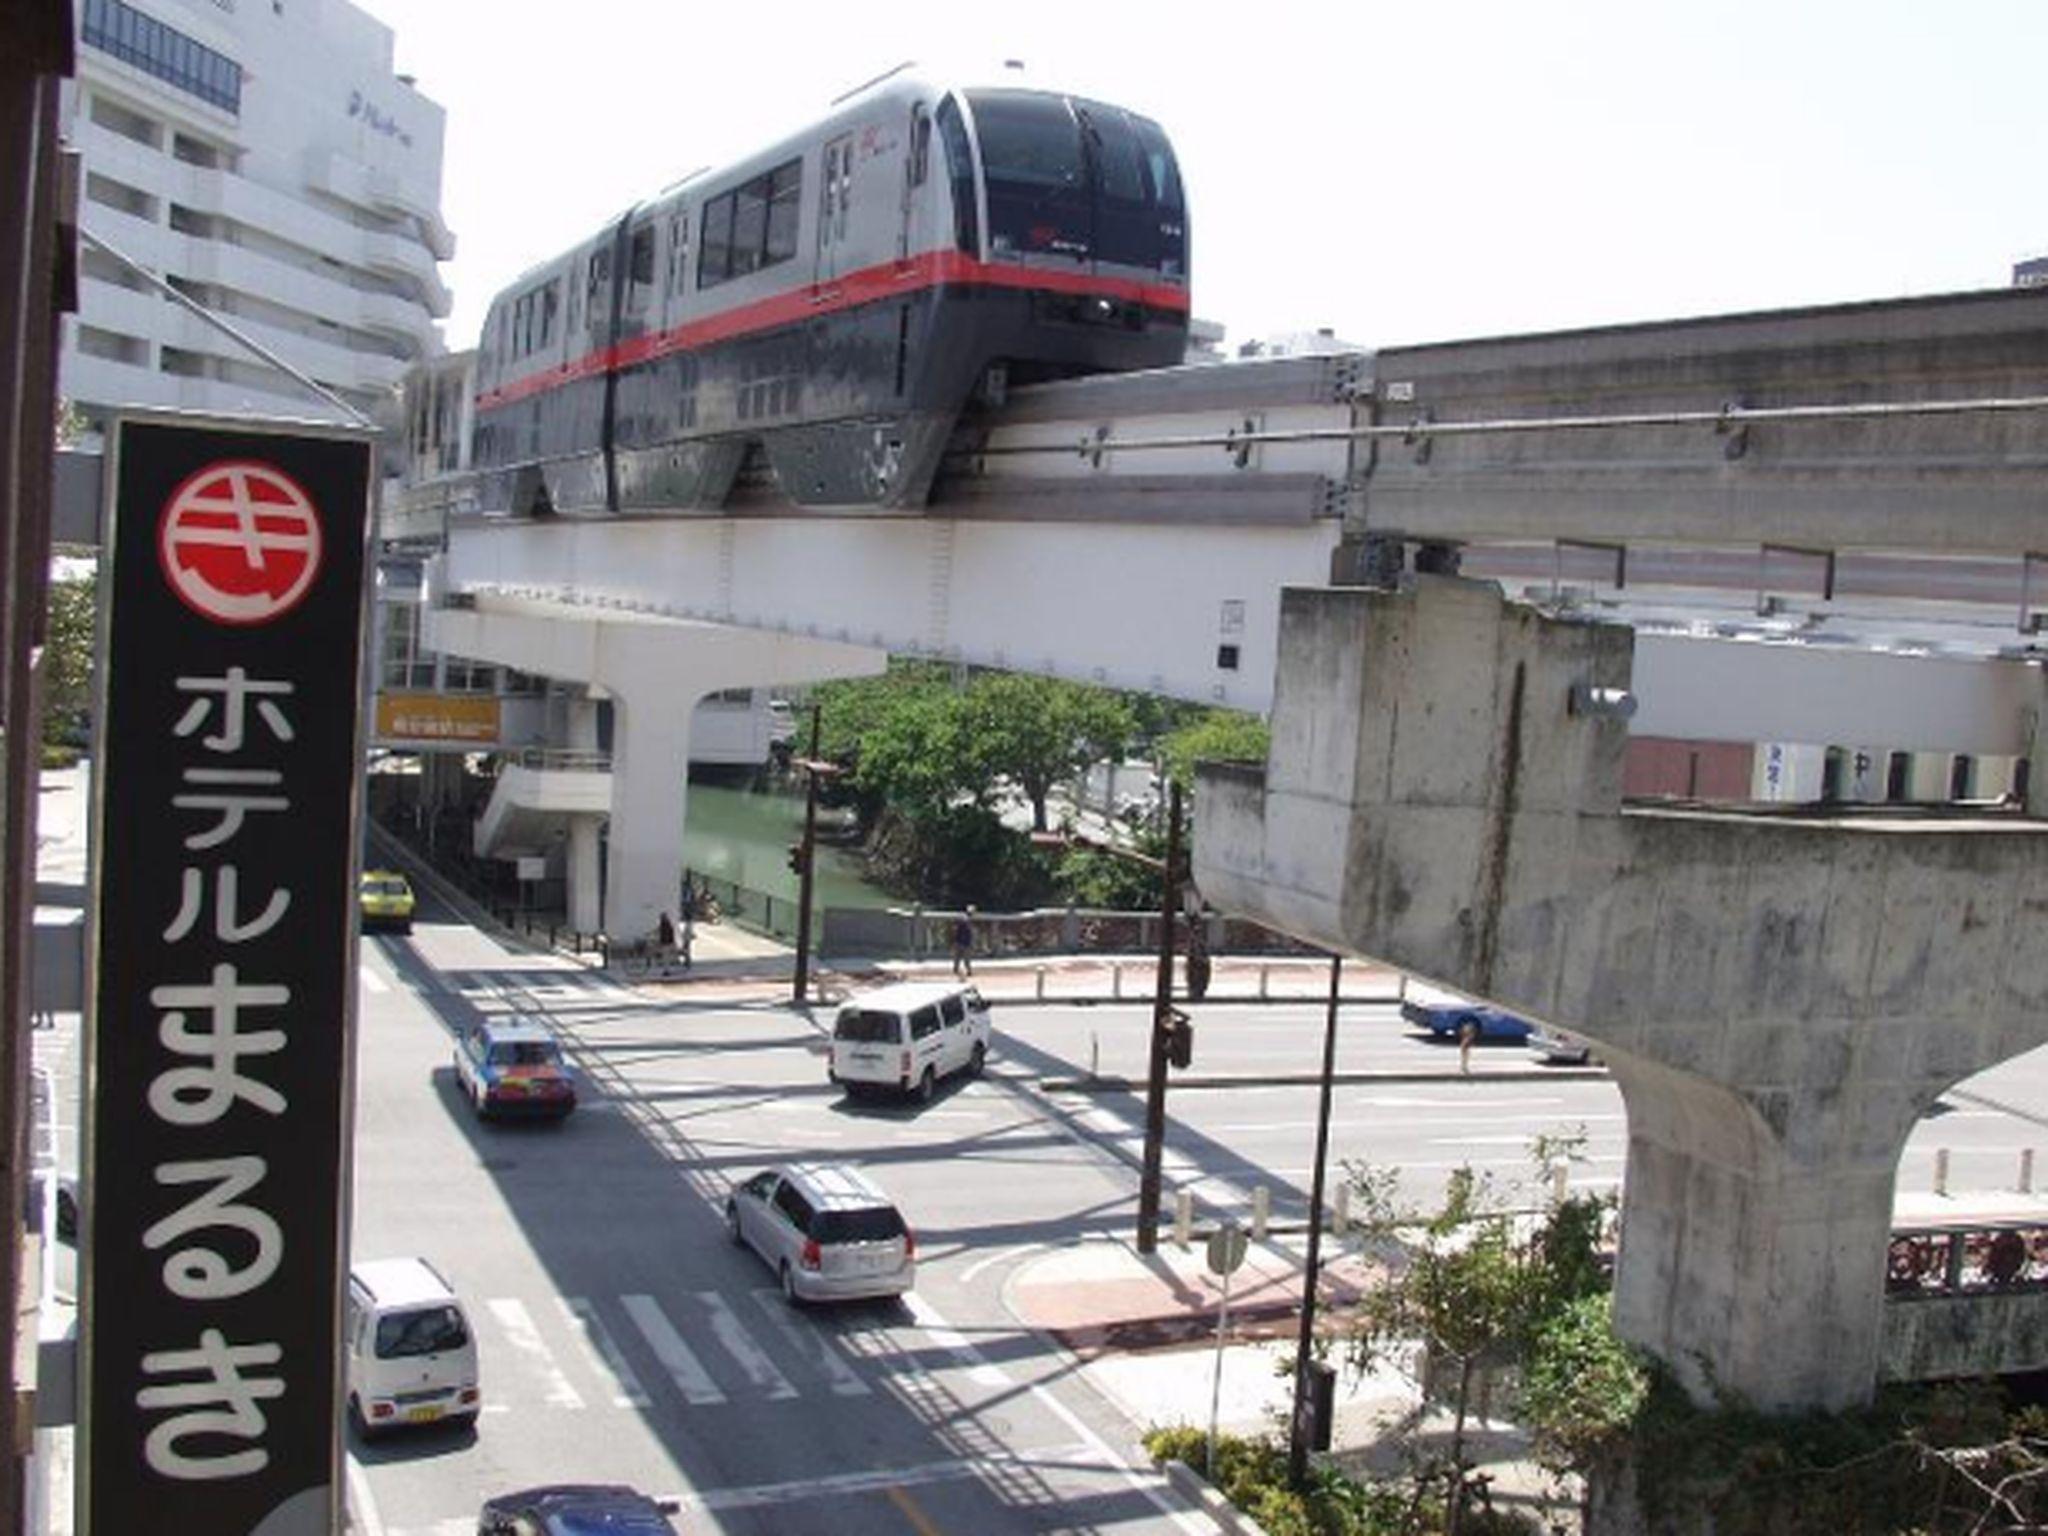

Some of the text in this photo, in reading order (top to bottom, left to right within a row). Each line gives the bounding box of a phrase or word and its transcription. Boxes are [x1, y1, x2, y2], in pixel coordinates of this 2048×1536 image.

[137, 667, 292, 1479] ホテルまるき
